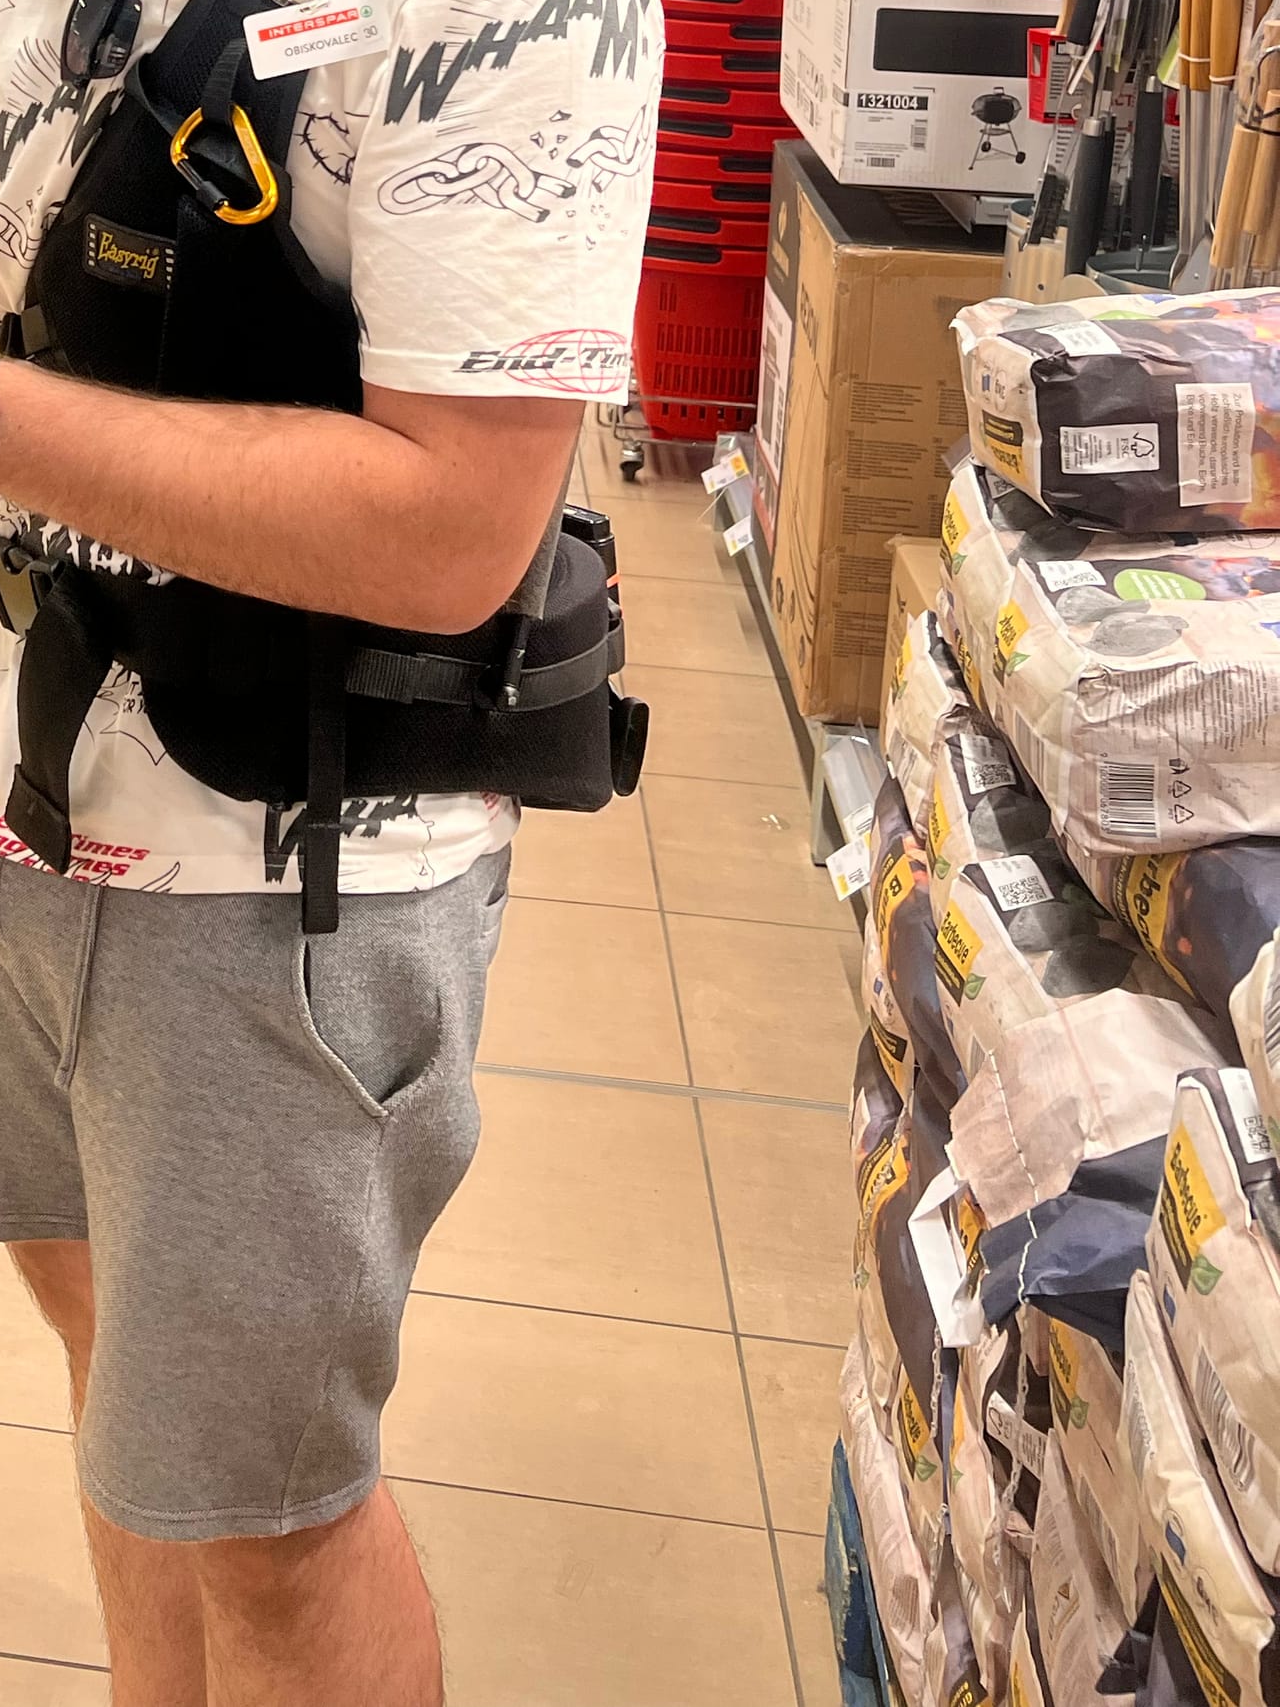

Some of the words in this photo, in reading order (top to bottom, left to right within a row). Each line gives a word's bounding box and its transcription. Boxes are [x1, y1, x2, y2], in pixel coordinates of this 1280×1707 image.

[268, 8, 358, 40] INTERSPAR
[284, 31, 359, 58] OBISKOVALEC
[365, 25, 379, 40] 30
[860, 94, 918, 109] 1321004
[97, 231, 160, 279] Easyrig
[1120, 438, 1130, 458] FSC
[71, 856, 131, 877] mes
[941, 911, 970, 965] Barbecue
